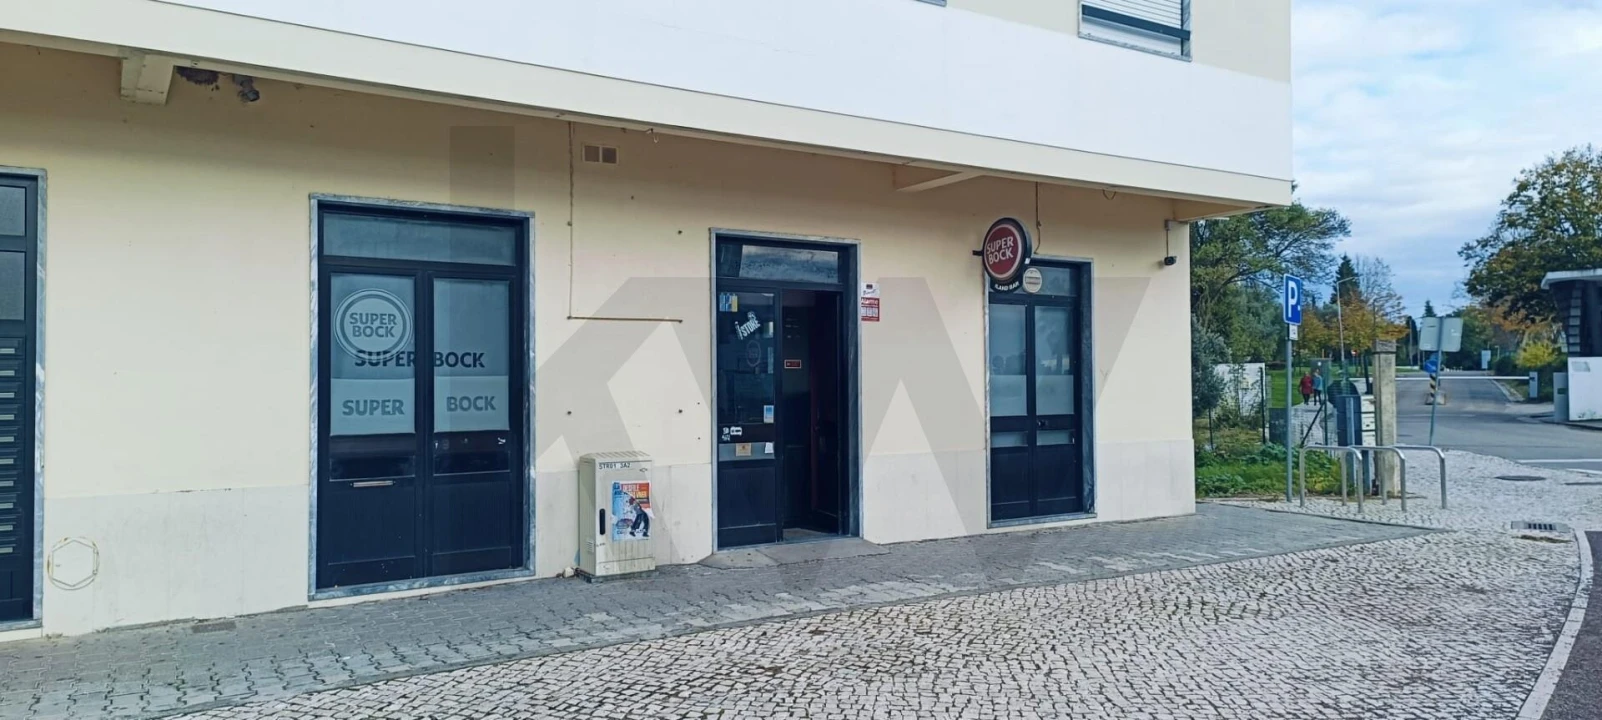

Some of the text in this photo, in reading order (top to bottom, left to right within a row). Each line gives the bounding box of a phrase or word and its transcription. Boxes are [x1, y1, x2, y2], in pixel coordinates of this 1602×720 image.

[987, 237, 1013, 254] SUPER
[988, 247, 1013, 264] BOCK
[1287, 280, 1299, 318] P
[349, 312, 398, 326] SUPER
[352, 325, 395, 338] BOCK
[354, 350, 486, 369] SUPER BOCK
[342, 396, 497, 416] SUPER BOCK
